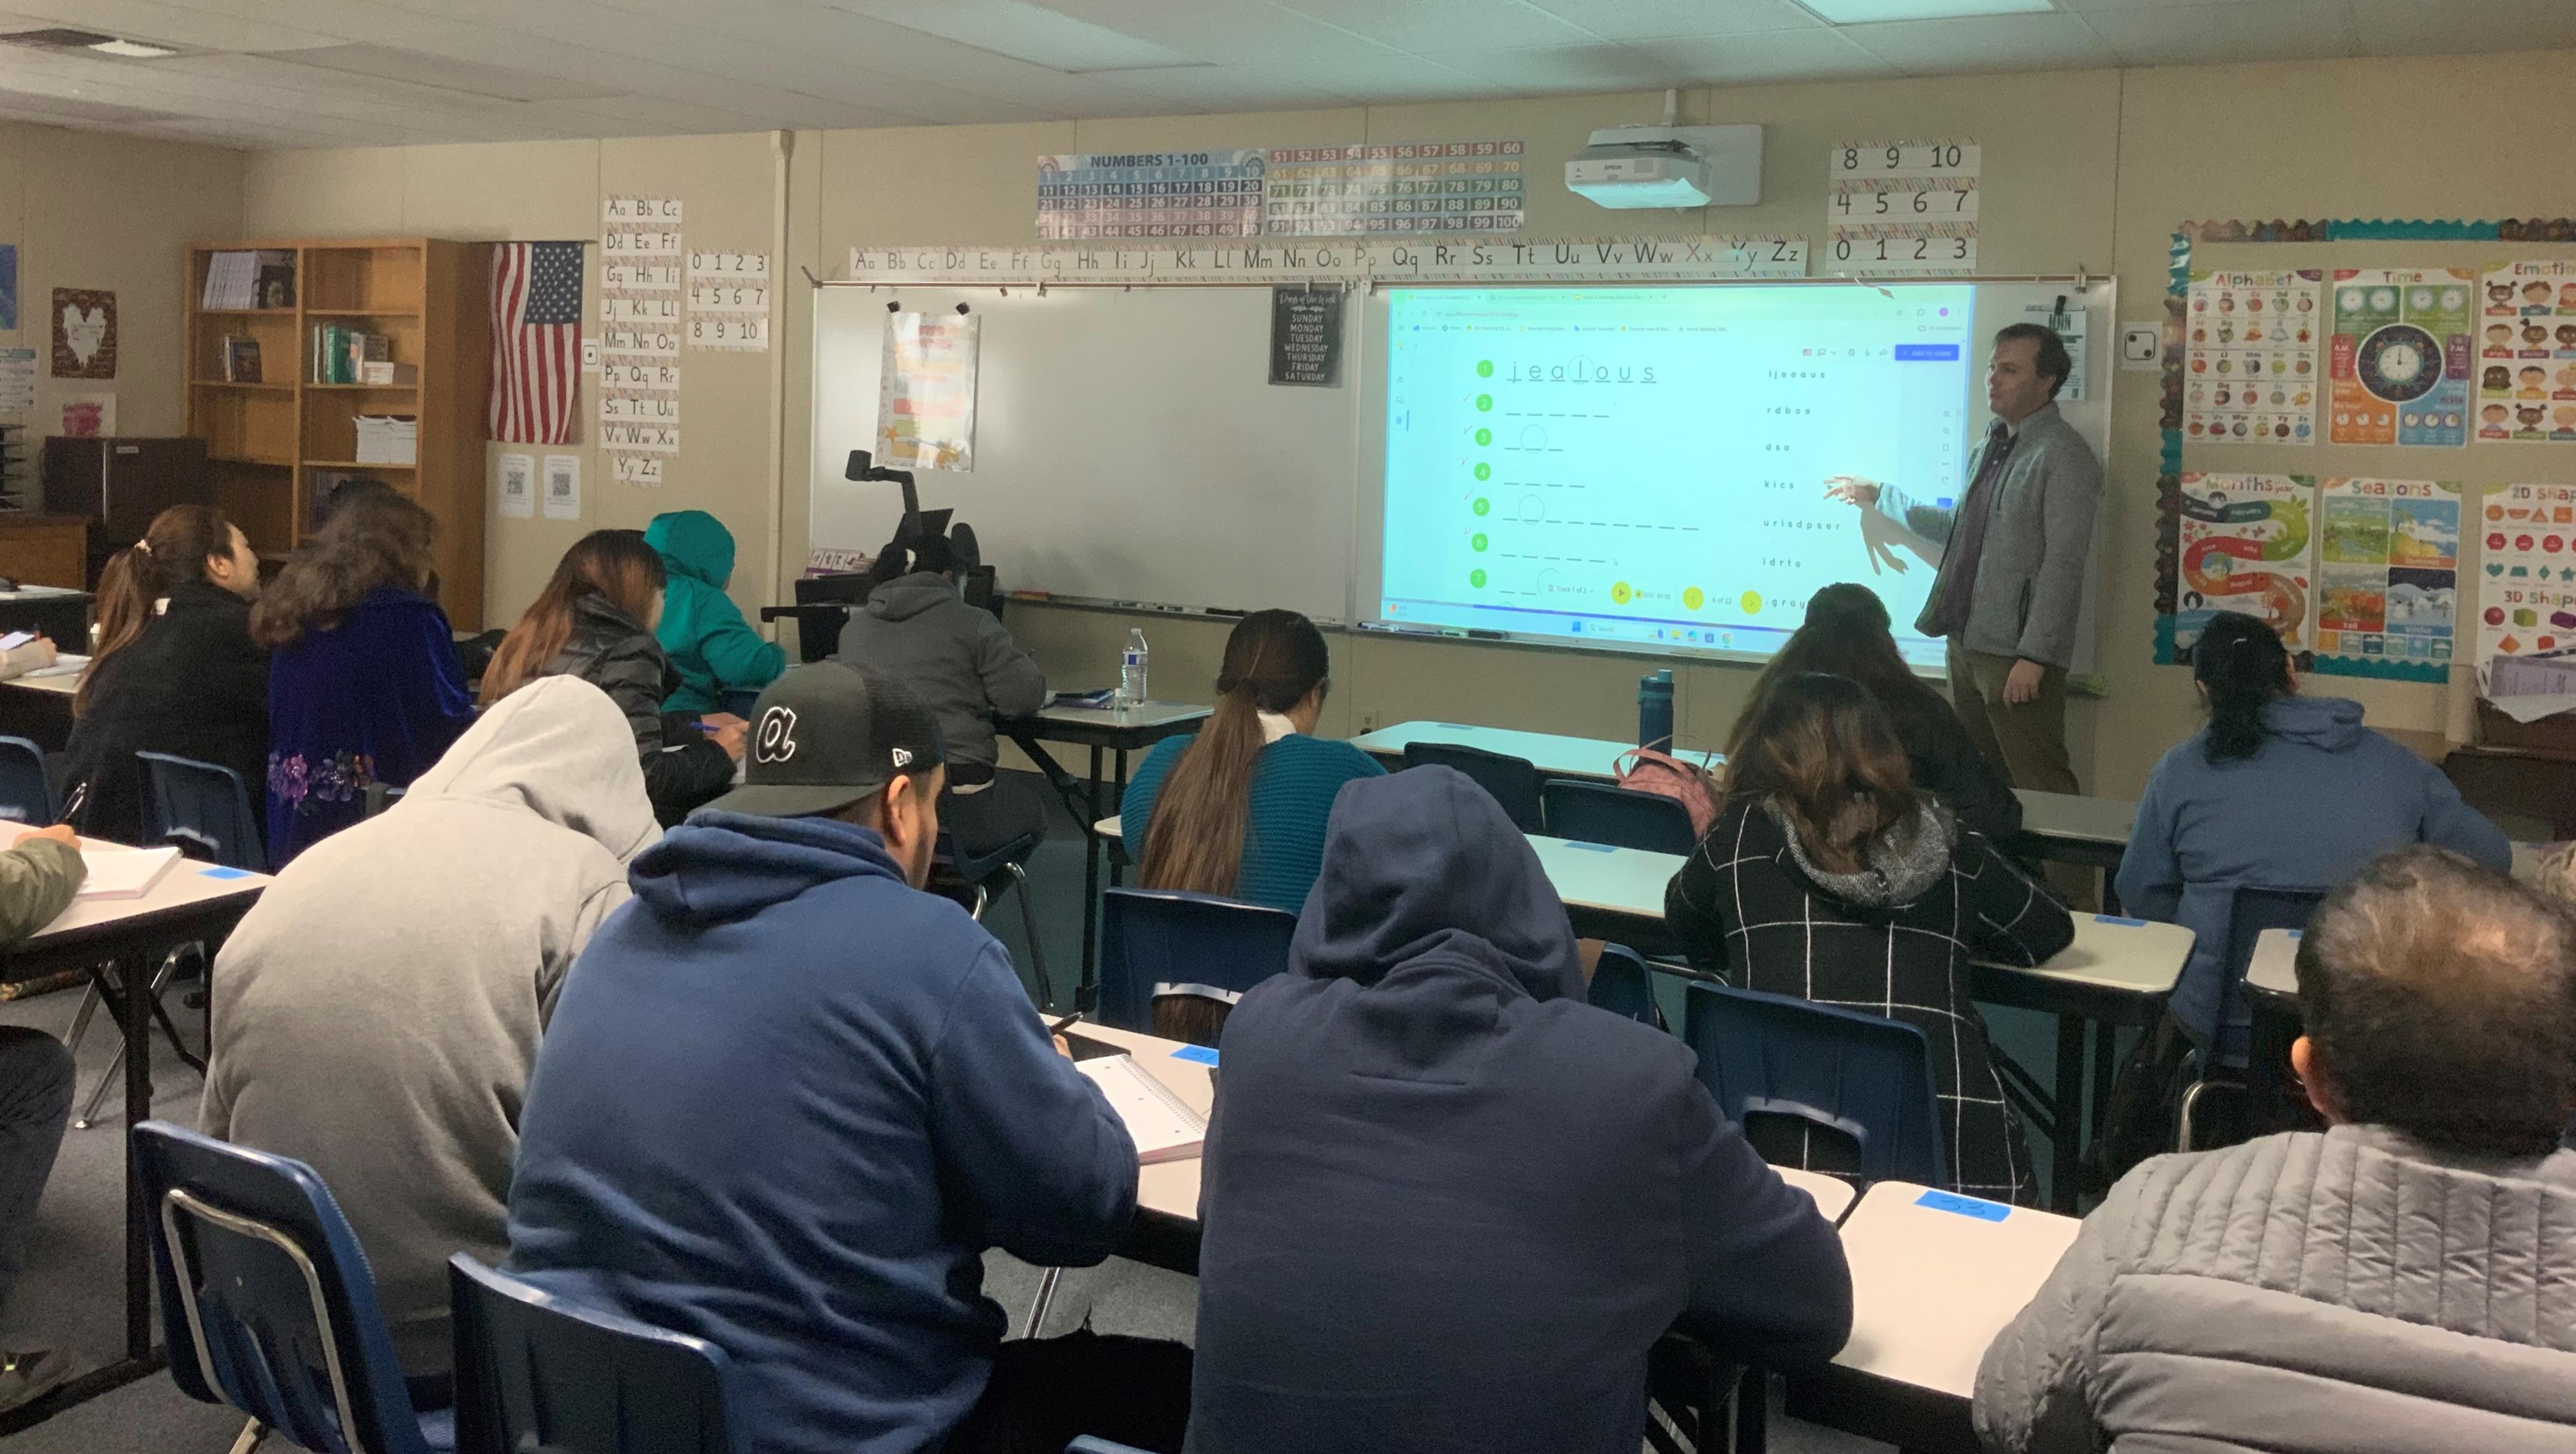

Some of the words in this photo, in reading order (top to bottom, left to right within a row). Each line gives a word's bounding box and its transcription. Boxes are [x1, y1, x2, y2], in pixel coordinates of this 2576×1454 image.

[1477, 144, 1492, 153] 59
[1504, 142, 1519, 153] 60
[1091, 154, 1163, 168] NUMBERS
[1168, 153, 1208, 165] 1-100
[1844, 148, 1857, 169] 8
[1887, 148, 1899, 169] 9
[1932, 145, 1961, 167] 10
[1042, 185, 1054, 195] 11
[1064, 185, 1076, 195] 12
[1085, 185, 1098, 195] 13
[1107, 185, 1120, 194] 14
[1130, 184, 1143, 194] 15
[1152, 183, 1165, 193] 16
[1175, 183, 1188, 193] 17
[1199, 183, 1211, 192] 18
[1222, 182, 1234, 191] 19
[1245, 181, 1259, 191] 20
[1502, 180, 1518, 190] 80
[609, 201, 625, 216] Aa
[636, 201, 653, 216] Bb
[662, 201, 678, 217] Cc
[1474, 197, 1491, 210] 89
[1501, 197, 1518, 209] 90
[1837, 194, 1851, 215] 4
[1876, 192, 1888, 213] 5
[1913, 192, 1927, 212] 6
[1954, 190, 1968, 211] 7
[1474, 216, 1490, 227] 99
[1498, 216, 1519, 227] 100
[607, 234, 623, 249] Dd
[634, 234, 650, 249] Ee
[662, 234, 676, 249] Ff
[1836, 240, 1850, 261] 0
[1876, 239, 1887, 260] 1
[1914, 238, 1927, 259] 2
[1954, 238, 1966, 259] 3
[693, 255, 701, 270] 0
[715, 255, 721, 270] 1
[735, 256, 744, 271] 2
[756, 256, 764, 271] 3
[855, 253, 874, 269] Aa
[887, 253, 906, 269] Bb
[918, 253, 935, 270] Cc
[946, 252, 965, 269] Dd
[980, 252, 997, 269] Ee
[1012, 252, 1029, 269] Ff
[1041, 252, 1061, 281] Gg
[1078, 252, 1098, 269] Hh
[1140, 250, 1154, 277] Jj
[1177, 250, 1195, 268] Kk
[1215, 250, 1231, 268] Ll
[1245, 250, 1272, 268] Mm
[1284, 249, 1305, 268] Nn
[1317, 249, 1340, 267] Oo
[1355, 248, 1376, 275] Pp
[1393, 247, 1418, 275] Qq
[1436, 246, 1455, 264] Rr
[1473, 246, 1492, 264] Ss
[1513, 245, 1535, 264] Tt
[1556, 245, 1579, 264] Uu
[1597, 244, 1622, 264] Vv
[1634, 243, 1673, 263] Ww
[1685, 243, 1712, 262] Xx
[1731, 242, 1757, 271] Yy
[1771, 241, 1797, 261] Zz
[607, 266, 623, 287] Gg
[636, 268, 652, 283] Hh
[665, 268, 675, 284] Ii
[2216, 273, 2292, 288] Alphabet
[2384, 271, 2422, 283] Time
[692, 289, 700, 304] 4
[713, 289, 721, 304] 5
[733, 289, 742, 305] 6
[755, 289, 763, 305] 7
[606, 300, 617, 321] Jj
[632, 300, 648, 316] Kk
[662, 301, 675, 317] Ll
[1292, 314, 1323, 323] SUNDAY
[694, 323, 702, 337] 8
[716, 323, 724, 338] 9
[740, 323, 758, 339] 10
[1290, 325, 1324, 333] MONDAY
[605, 333, 625, 349] Mm
[633, 333, 650, 349] Nn
[657, 334, 675, 350] Oo
[1284, 344, 1329, 352] WEDNESDAY
[1287, 353, 1326, 362] THURSDAY
[1292, 363, 1319, 371] FRIDAY
[605, 366, 620, 388] Pp
[631, 366, 648, 388] Qq
[660, 367, 674, 383] Rr
[1285, 372, 1325, 381] SATURDAY
[606, 399, 618, 415] Ss
[631, 400, 645, 415] Tt
[657, 400, 673, 416] Uu
[605, 427, 621, 443] Vv
[626, 429, 650, 444] Ww
[657, 429, 674, 445] Xx
[618, 459, 634, 481] Yy
[641, 459, 657, 476] Zz
[2206, 477, 2273, 492] Months
[2352, 480, 2432, 496] Seasons
[2512, 487, 2531, 500] 2D
[1724, 597, 1732, 606] 22
[2504, 591, 2522, 602] 3D
